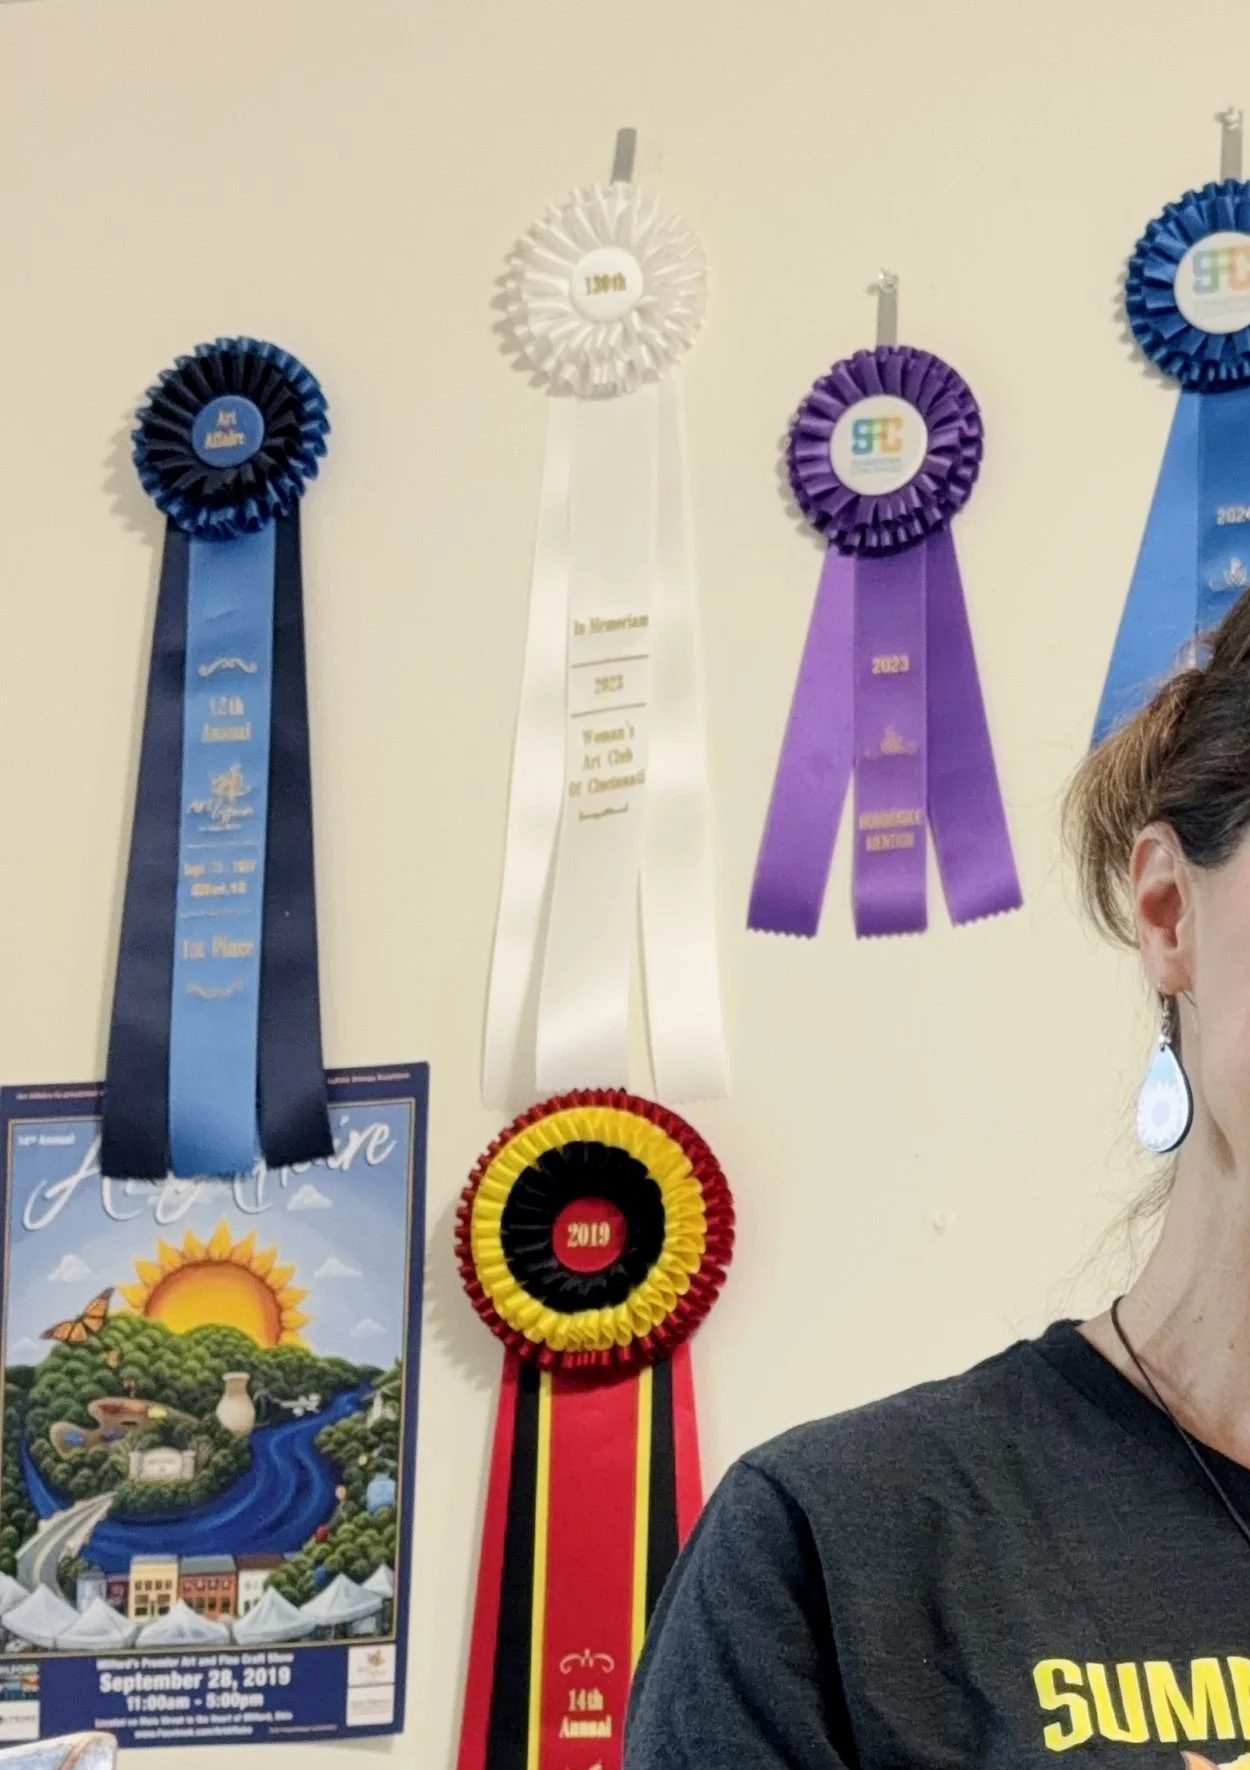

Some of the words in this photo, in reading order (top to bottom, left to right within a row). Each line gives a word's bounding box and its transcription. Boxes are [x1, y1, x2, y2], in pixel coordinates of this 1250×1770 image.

[567, 1221, 611, 1248] 2019
[100, 1670, 203, 1695] September
[207, 1668, 238, 1692] 28,
[243, 1665, 291, 1687] 2019
[126, 1694, 191, 1712] 11:00am
[568, 1687, 604, 1712] 14th
[558, 1714, 612, 1739] Annual
